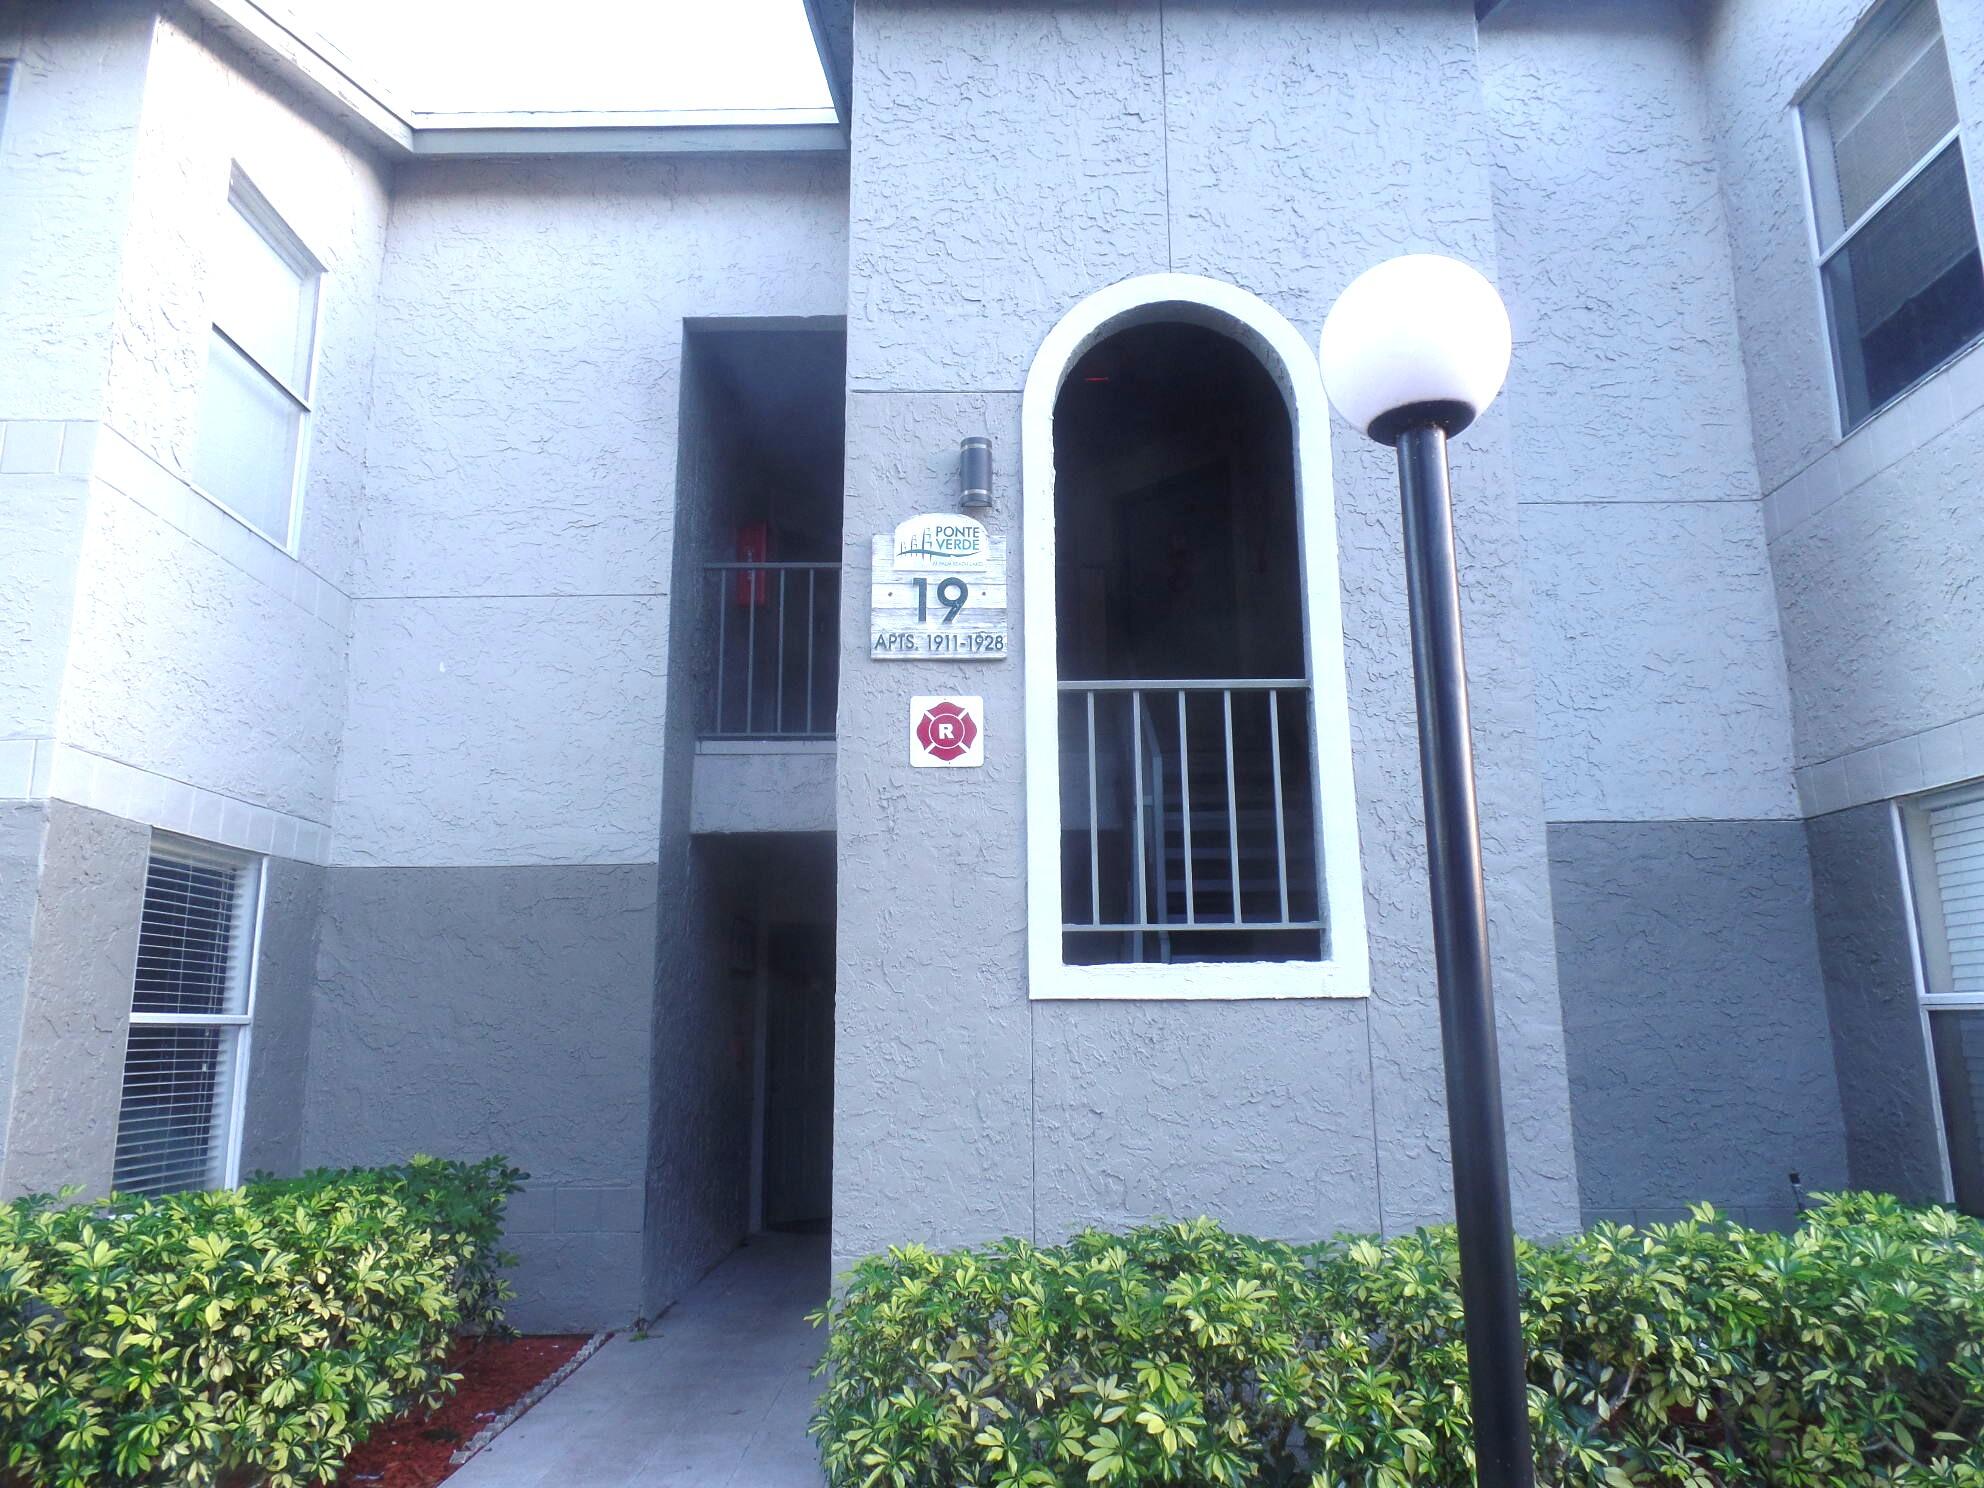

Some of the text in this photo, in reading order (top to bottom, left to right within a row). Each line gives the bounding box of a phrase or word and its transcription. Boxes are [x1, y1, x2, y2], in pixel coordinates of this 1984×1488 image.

[936, 526, 980, 538] PONTE
[935, 538, 980, 551] VERDE
[912, 576, 969, 625] 19
[874, 634, 1004, 651] APTS. 1911-1928
[938, 723, 955, 740] R
